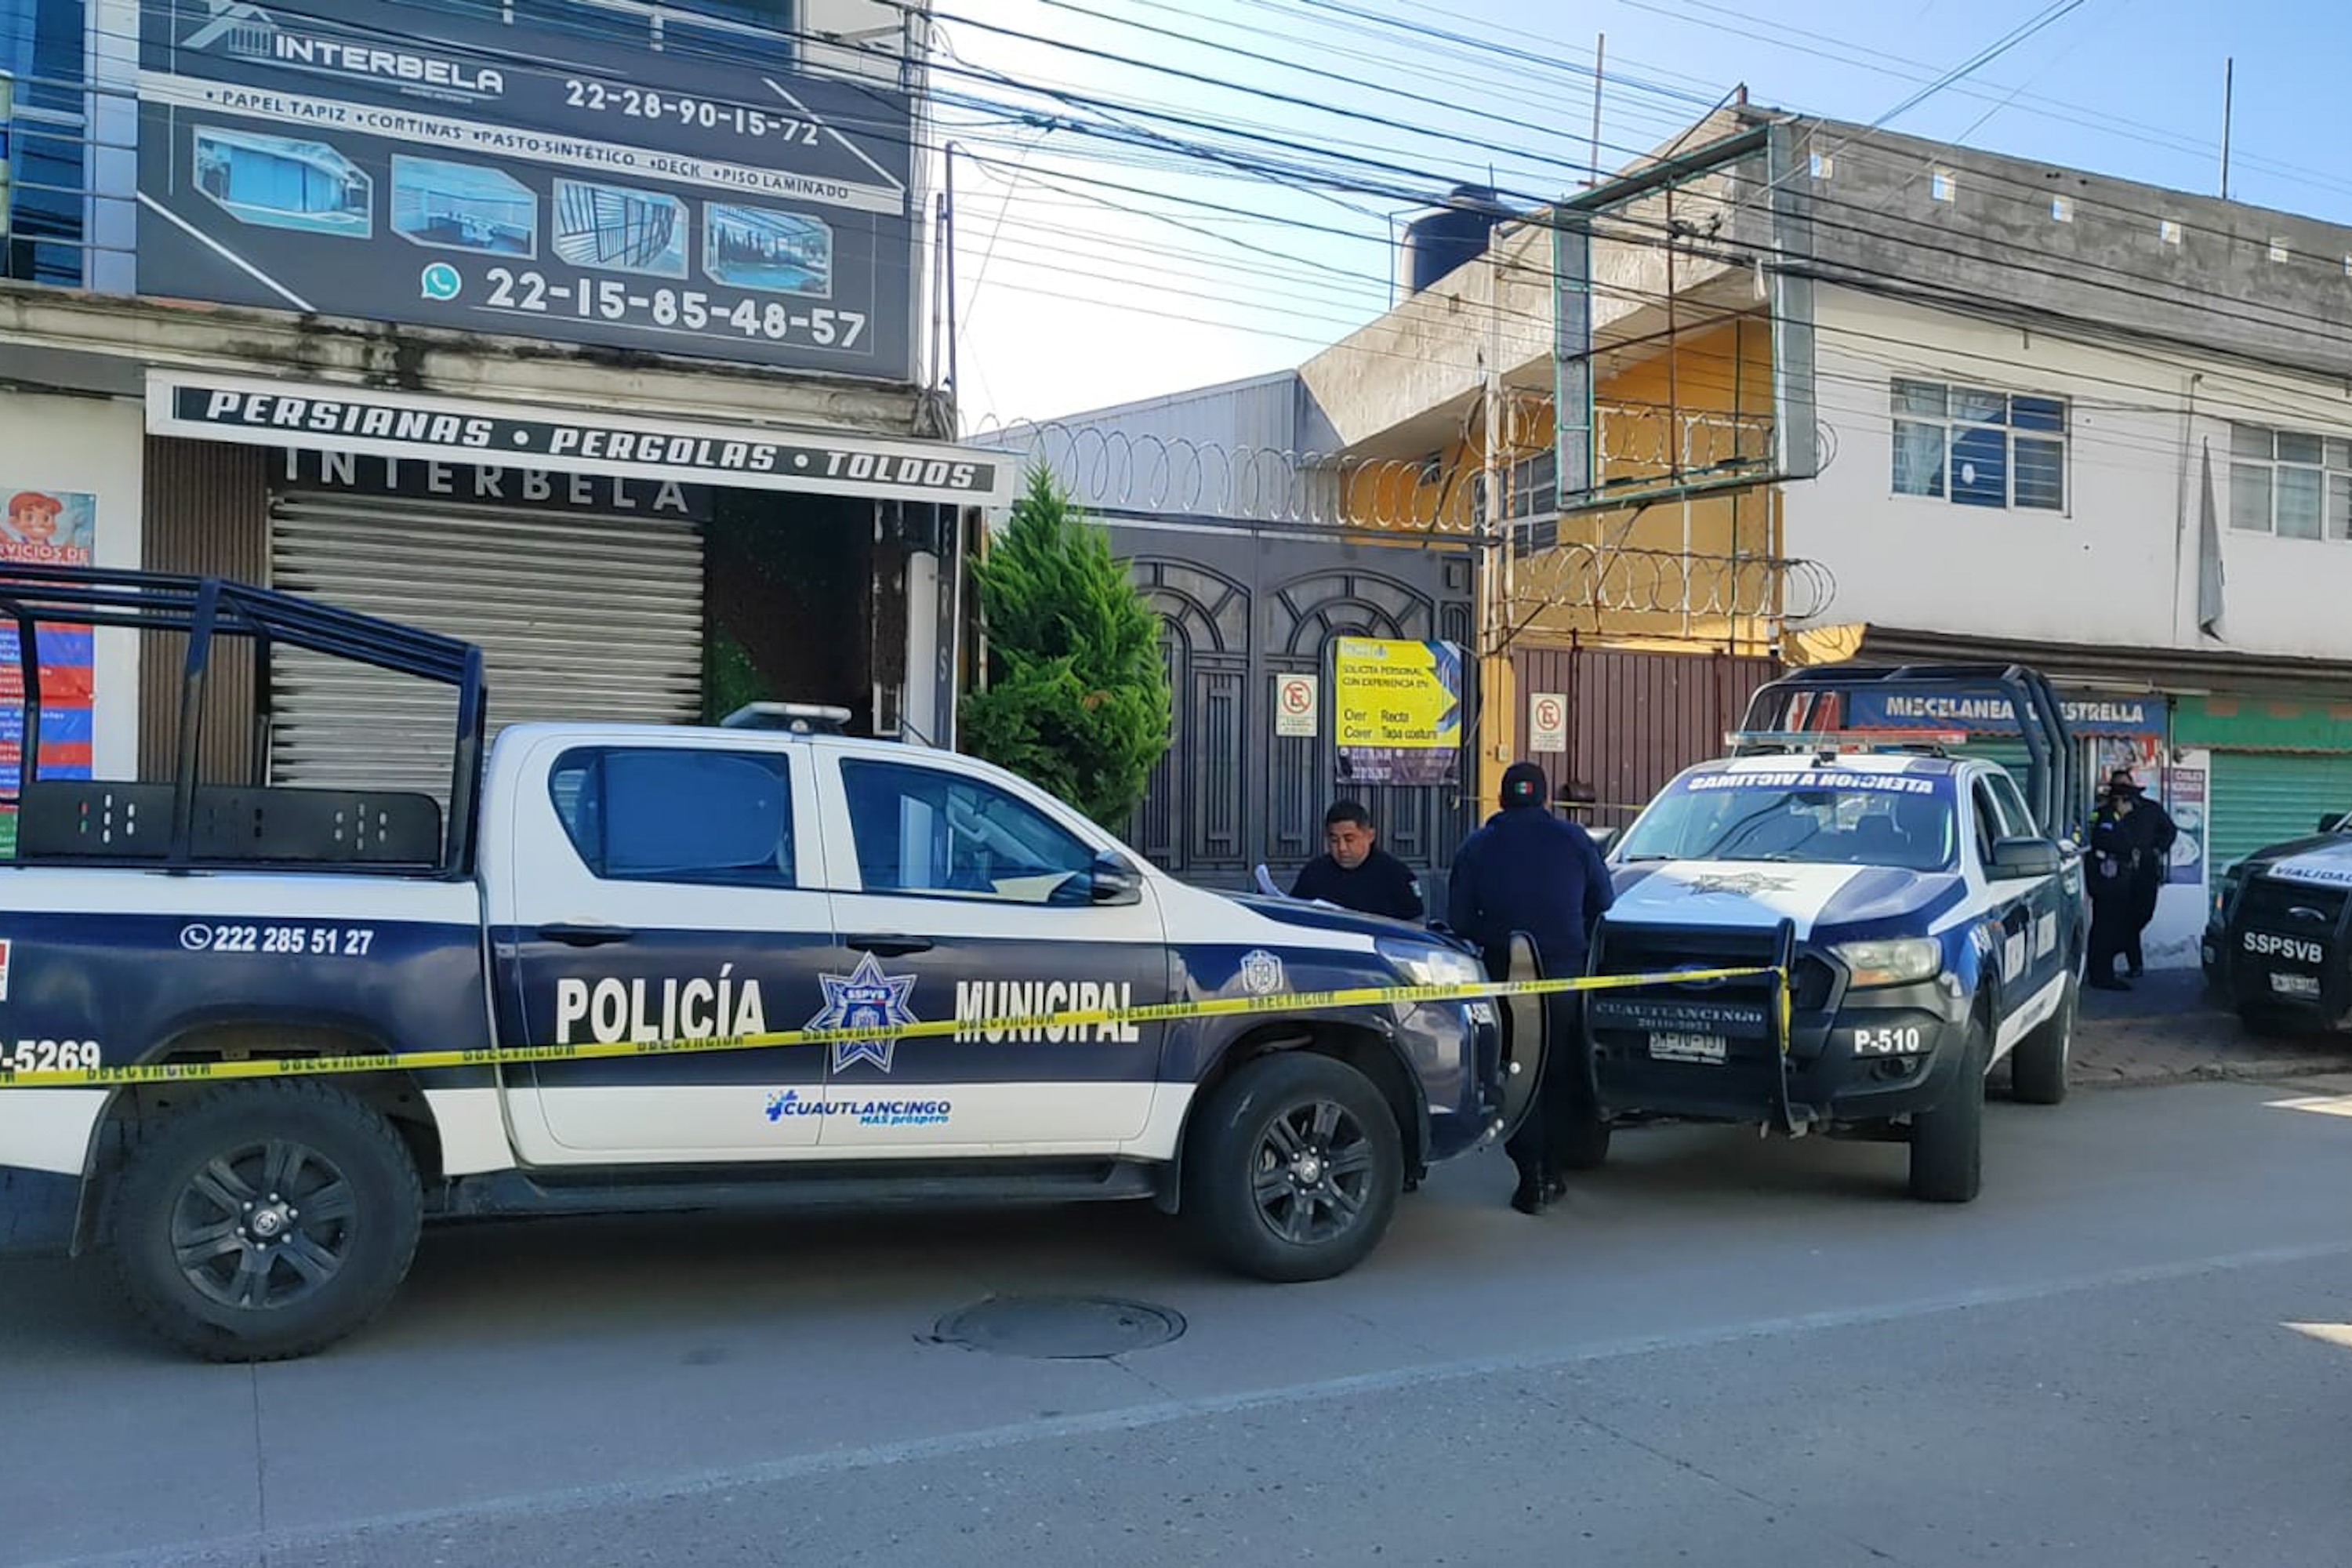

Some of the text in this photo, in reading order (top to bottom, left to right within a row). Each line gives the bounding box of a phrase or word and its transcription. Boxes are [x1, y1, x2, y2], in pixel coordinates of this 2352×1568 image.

[276, 34, 504, 93] INTERBELA
[565, 79, 819, 147] 22-28-90-15-72
[223, 90, 284, 113] PAPEL
[290, 101, 346, 122] TAPIZ
[368, 112, 463, 140] CORTINAS
[481, 131, 539, 152] PASTO
[656, 158, 701, 178] DECK
[722, 169, 758, 186] PISO
[763, 176, 848, 199] LAMINADO
[485, 267, 866, 349] 22-15-85-48-57
[206, 390, 976, 488] PERSIANAS PERGOLAS TOLDOS
[1344, 708, 1410, 723] Over Recta
[1886, 696, 2015, 720] MISCELANEA
[1344, 725, 1372, 739] Cover
[1381, 726, 1403, 741] Tapa
[212, 926, 374, 956] 222 285 51 27
[2243, 931, 2323, 964] SSPSVB
[557, 962, 1140, 1044] POLICÍA MUNICIPAL
[1595, 1002, 1762, 1022] CUAUTLANCINGO
[0, 1040, 101, 1073] -5269
[1854, 1027, 1919, 1053] P-510
[784, 1101, 952, 1116] CUAUTLANCINGO
